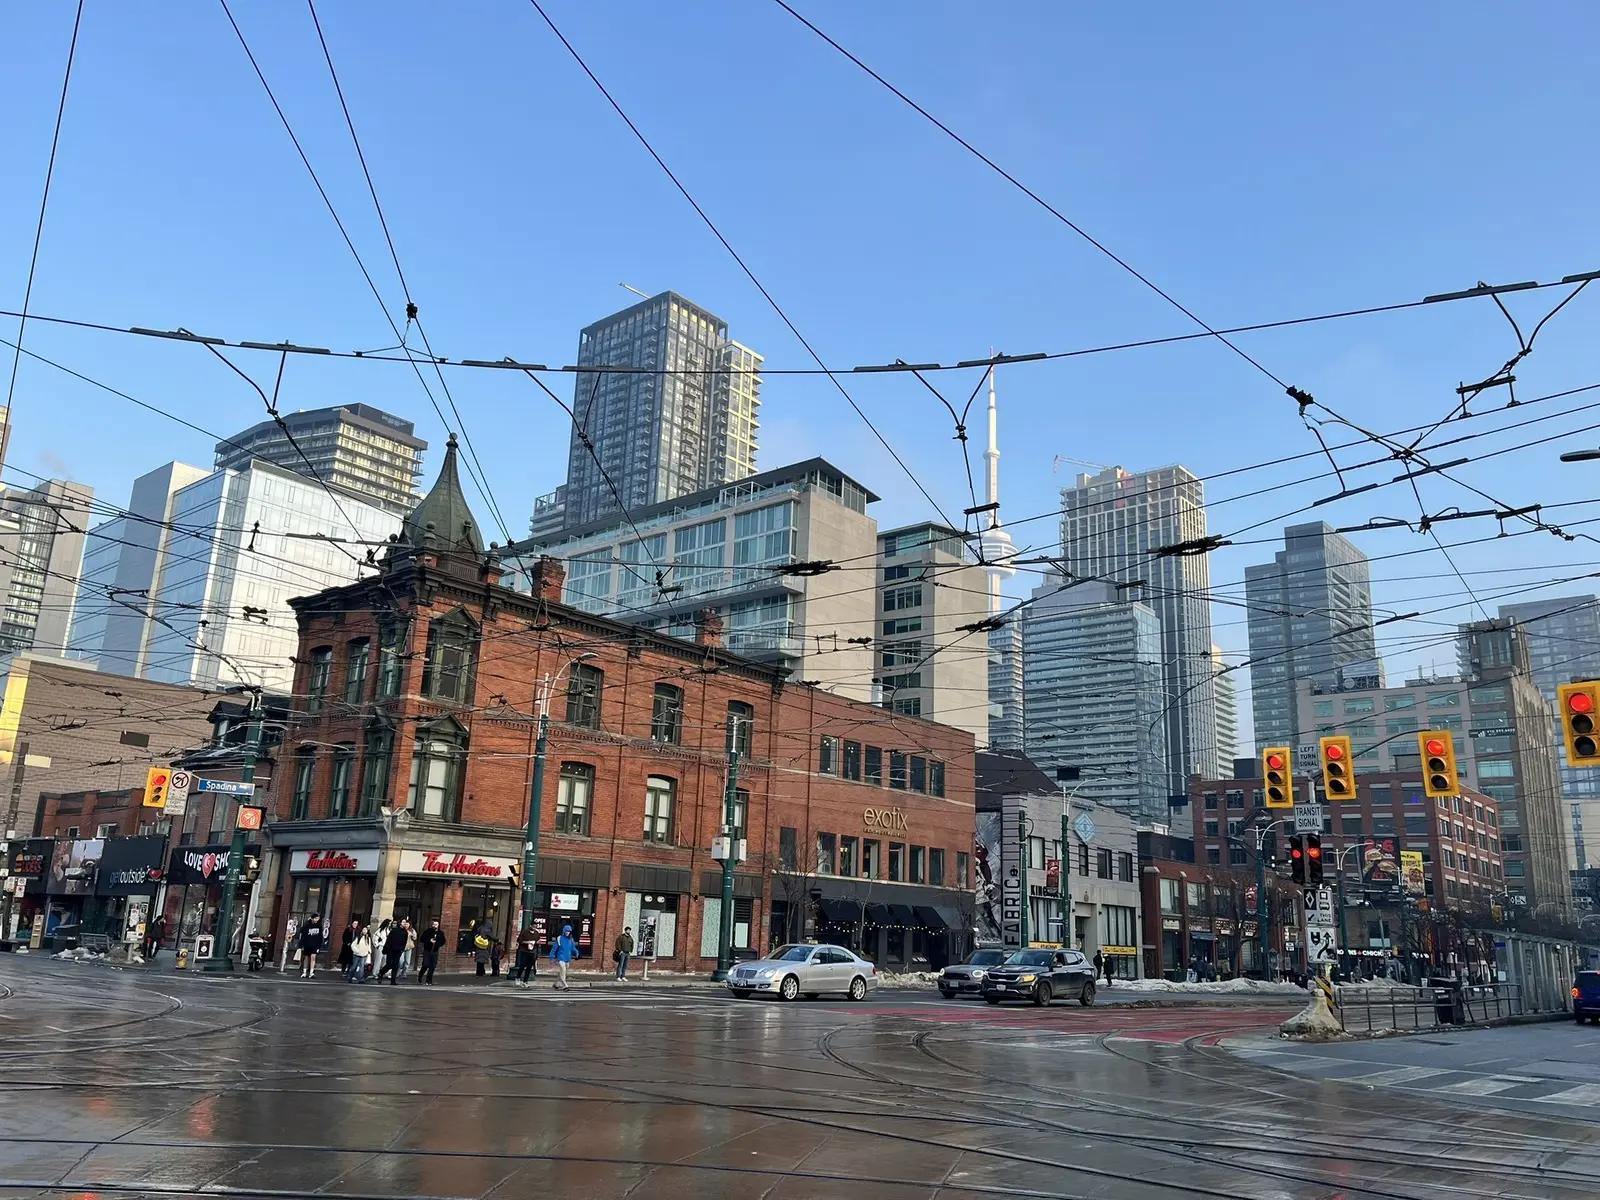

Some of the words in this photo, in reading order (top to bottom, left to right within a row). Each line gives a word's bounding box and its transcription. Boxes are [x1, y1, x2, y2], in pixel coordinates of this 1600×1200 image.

[206, 780, 237, 791] Spadina
[863, 807, 909, 831] exotix
[1296, 807, 1320, 817] TRANSIT
[1298, 818, 1320, 827] SIGNAL
[184, 850, 203, 871] LOVE
[306, 850, 321, 869] Tim
[321, 850, 358, 869] Hortons
[422, 852, 449, 873] Tim
[448, 853, 502, 876] Hortons
[1004, 879, 1020, 946] FABRIC
